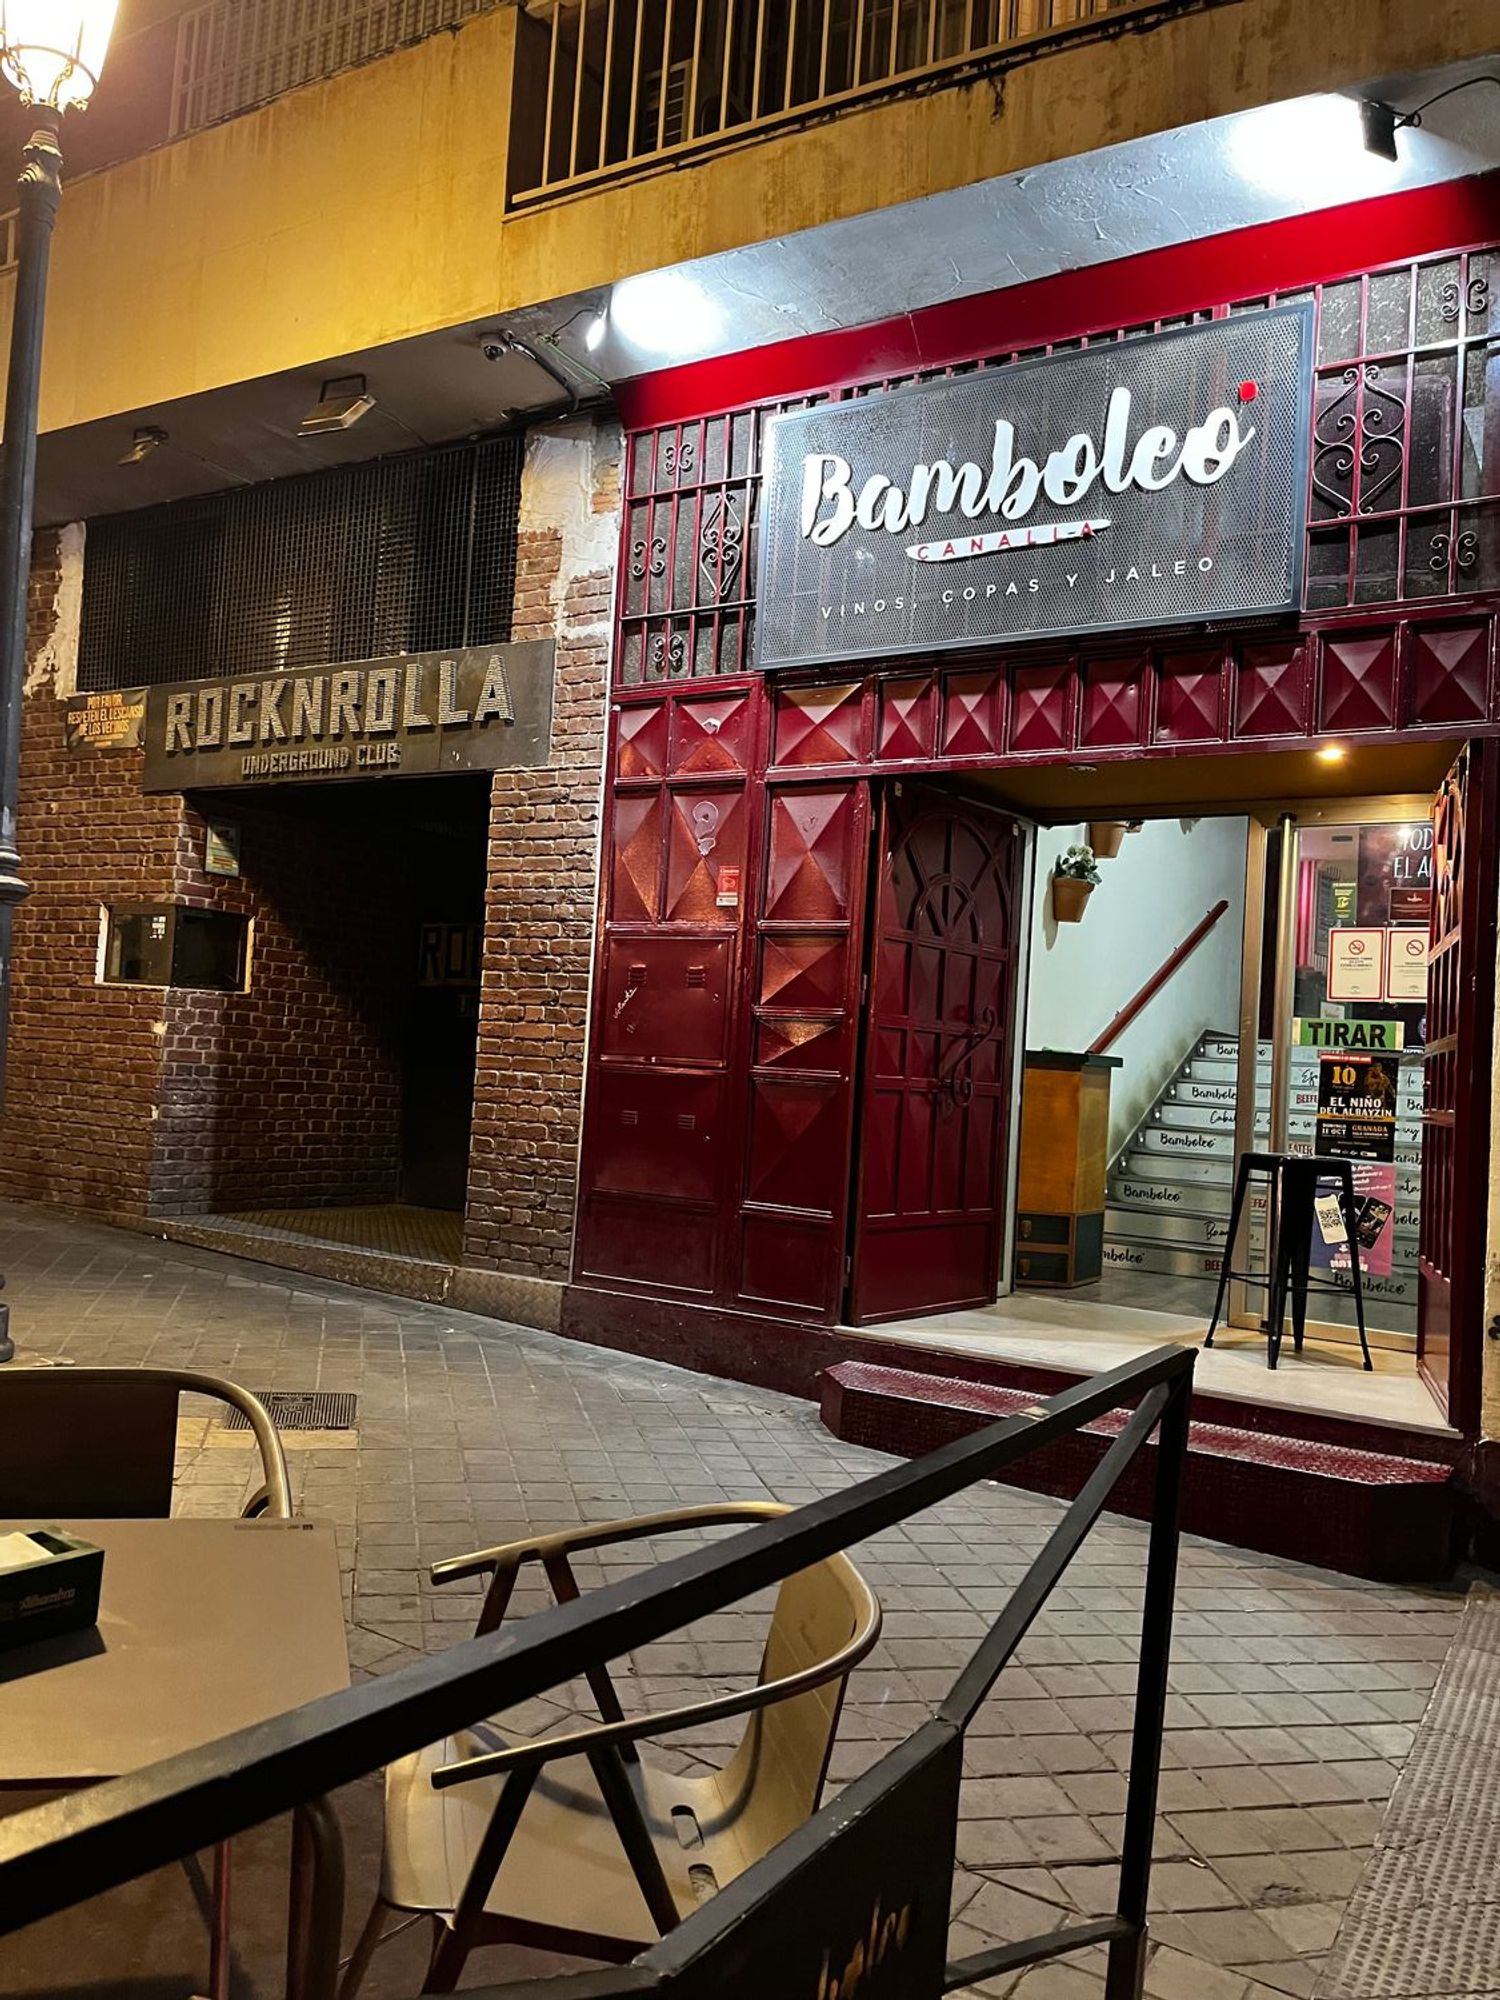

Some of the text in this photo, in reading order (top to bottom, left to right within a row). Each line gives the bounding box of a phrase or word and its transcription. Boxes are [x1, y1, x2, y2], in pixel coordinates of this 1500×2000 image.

[801, 386, 1256, 547] Bamboleo
[916, 520, 1097, 562] CANALLA
[821, 556, 1215, 620] VINOS, COPAS Y JALEO
[100, 708, 108, 721] EL
[164, 653, 516, 753] ROCKNROLLA
[88, 721, 101, 735] LOS
[240, 742, 402, 776] UNDERGROUND CLUB
[1394, 856, 1412, 879] EL
[1308, 1021, 1387, 1048] TIRAR
[1332, 1065, 1356, 1085] 10
[1319, 1106, 1339, 1115] DEL
[1330, 1095, 1382, 1108] EL NIÑO
[1160, 1133, 1215, 1148] Bamboleo
[1124, 1184, 1182, 1202] Bamboleo
[19, 1587, 76, 1610] Alhambra
